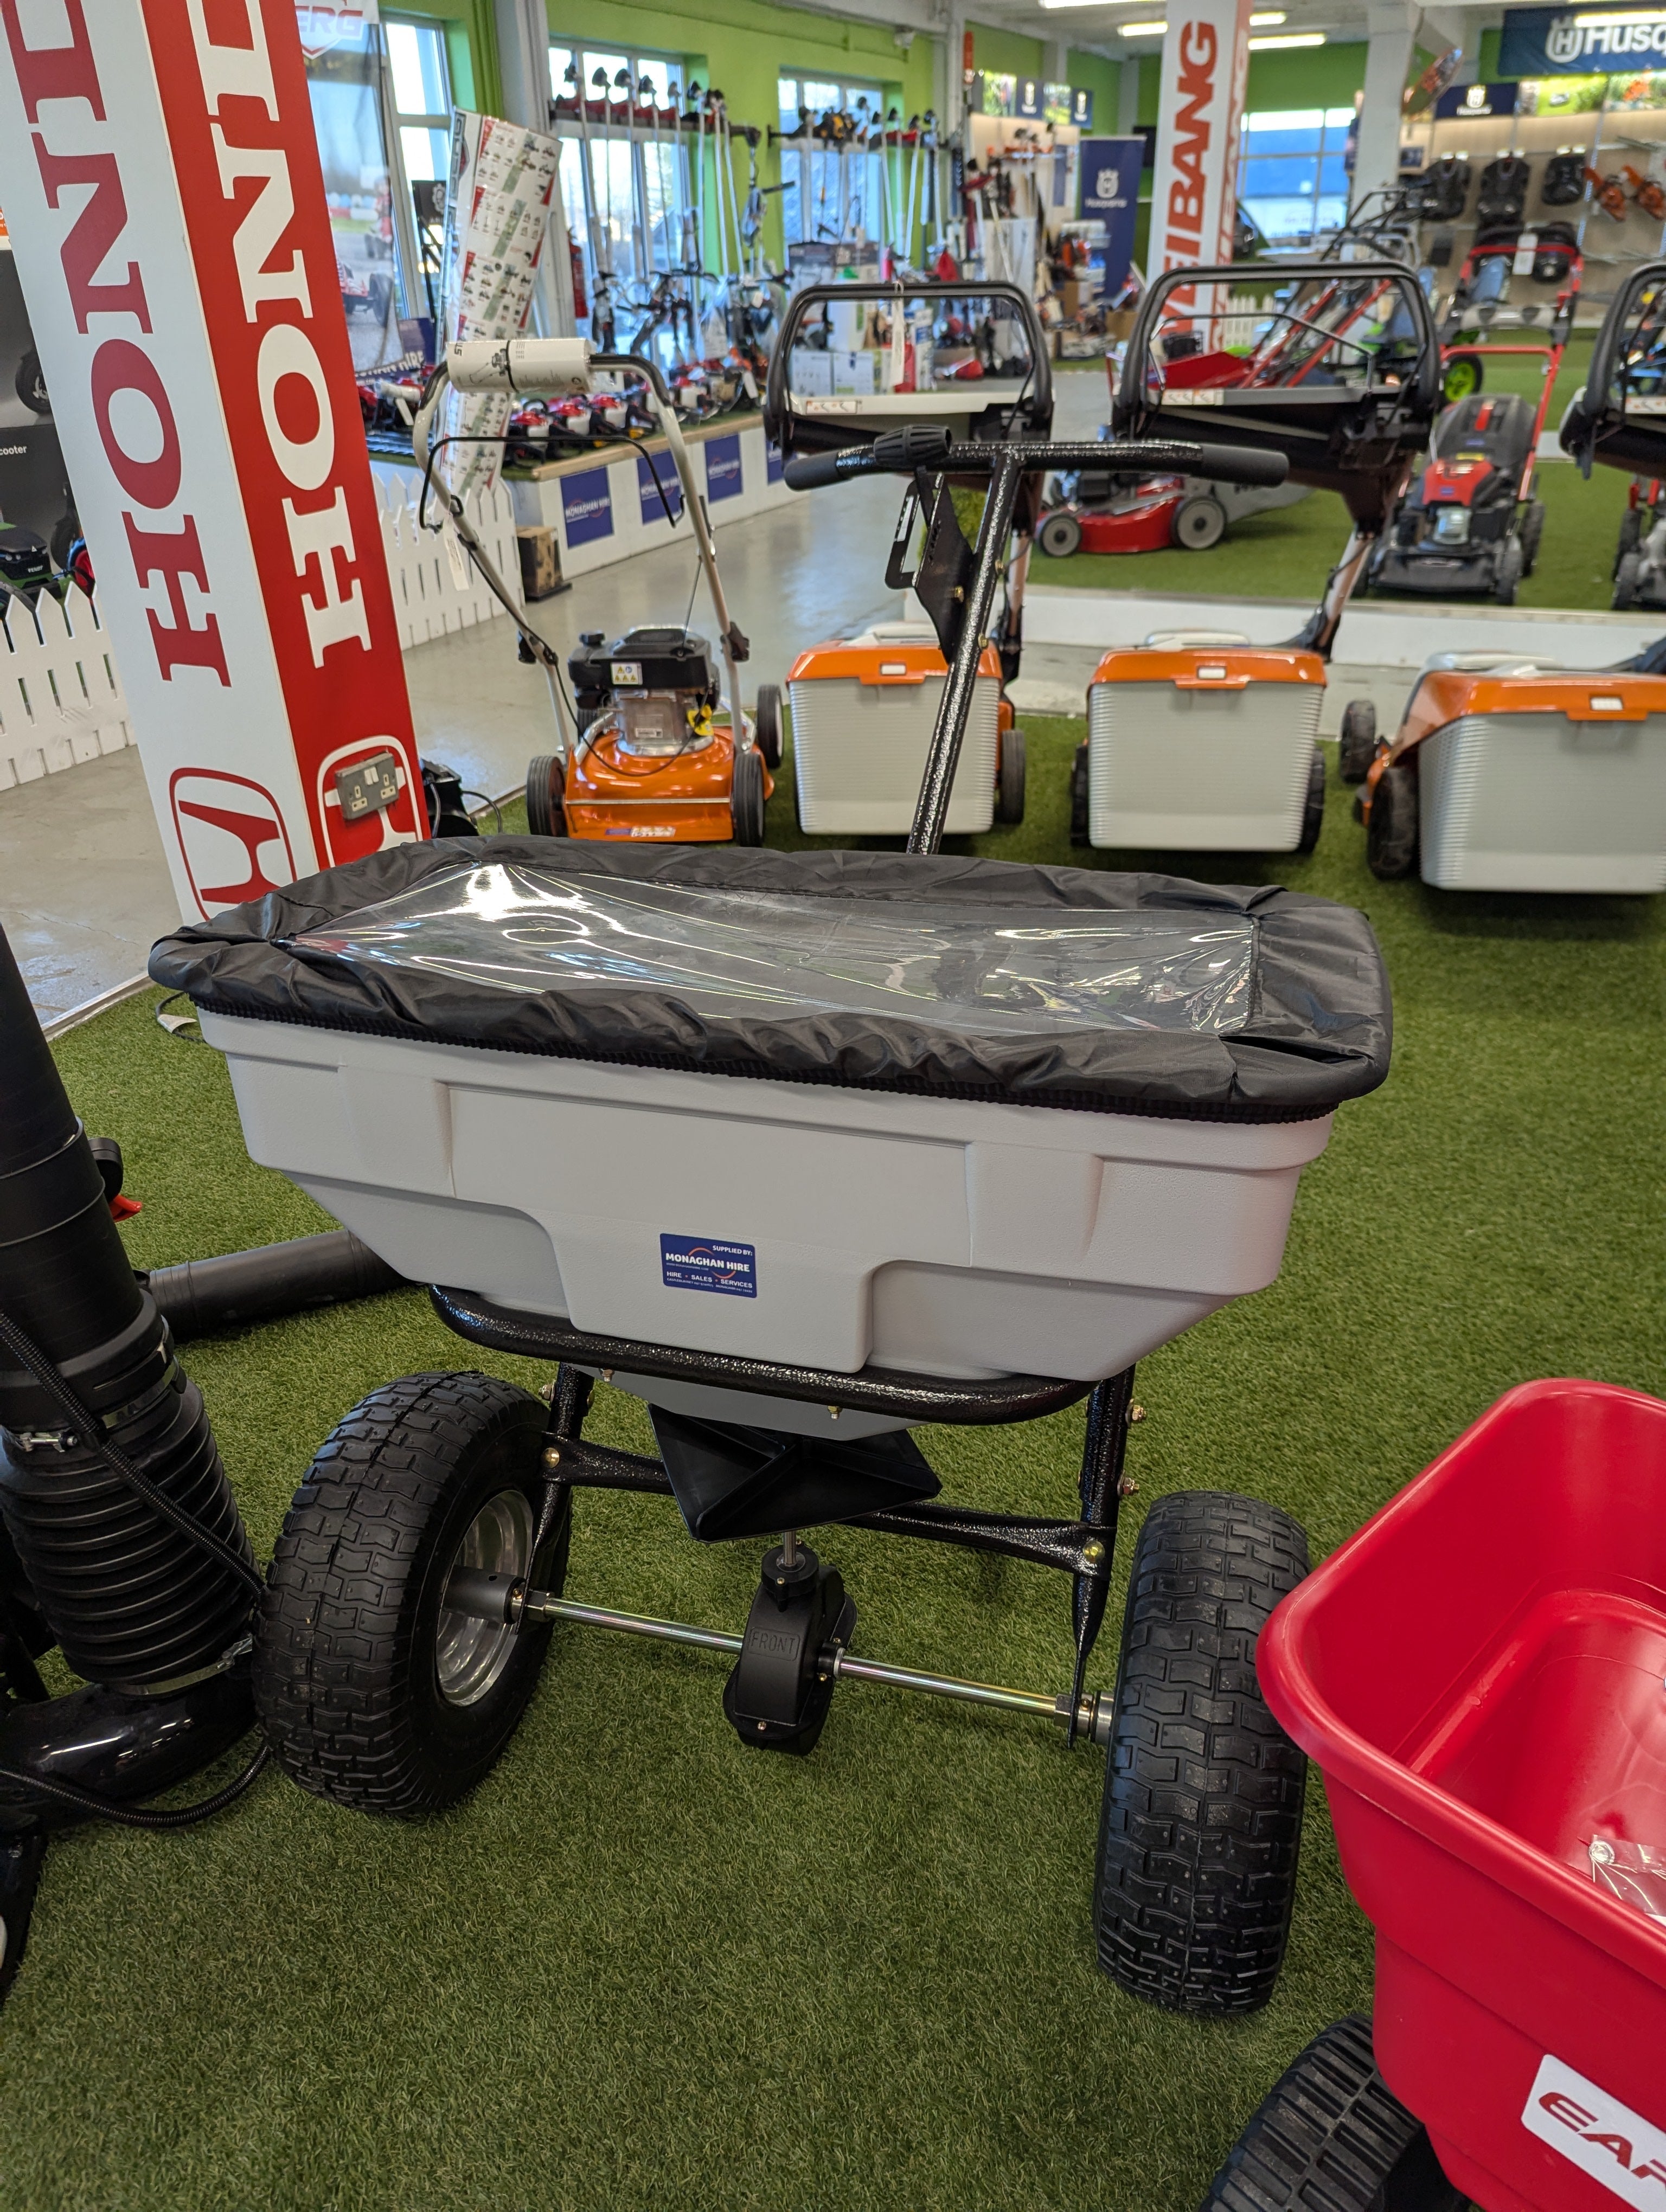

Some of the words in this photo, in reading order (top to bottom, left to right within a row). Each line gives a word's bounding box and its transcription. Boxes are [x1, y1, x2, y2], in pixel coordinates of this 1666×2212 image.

[713, 1245, 742, 1255] SUPPLIED
[666, 1253, 725, 1268] MONAGHAN
[726, 1261, 751, 1272] HIRE
[691, 1275, 713, 1283] SALES
[720, 1279, 753, 1289] SERVICES
[751, 1630, 796, 1654] FRONT
